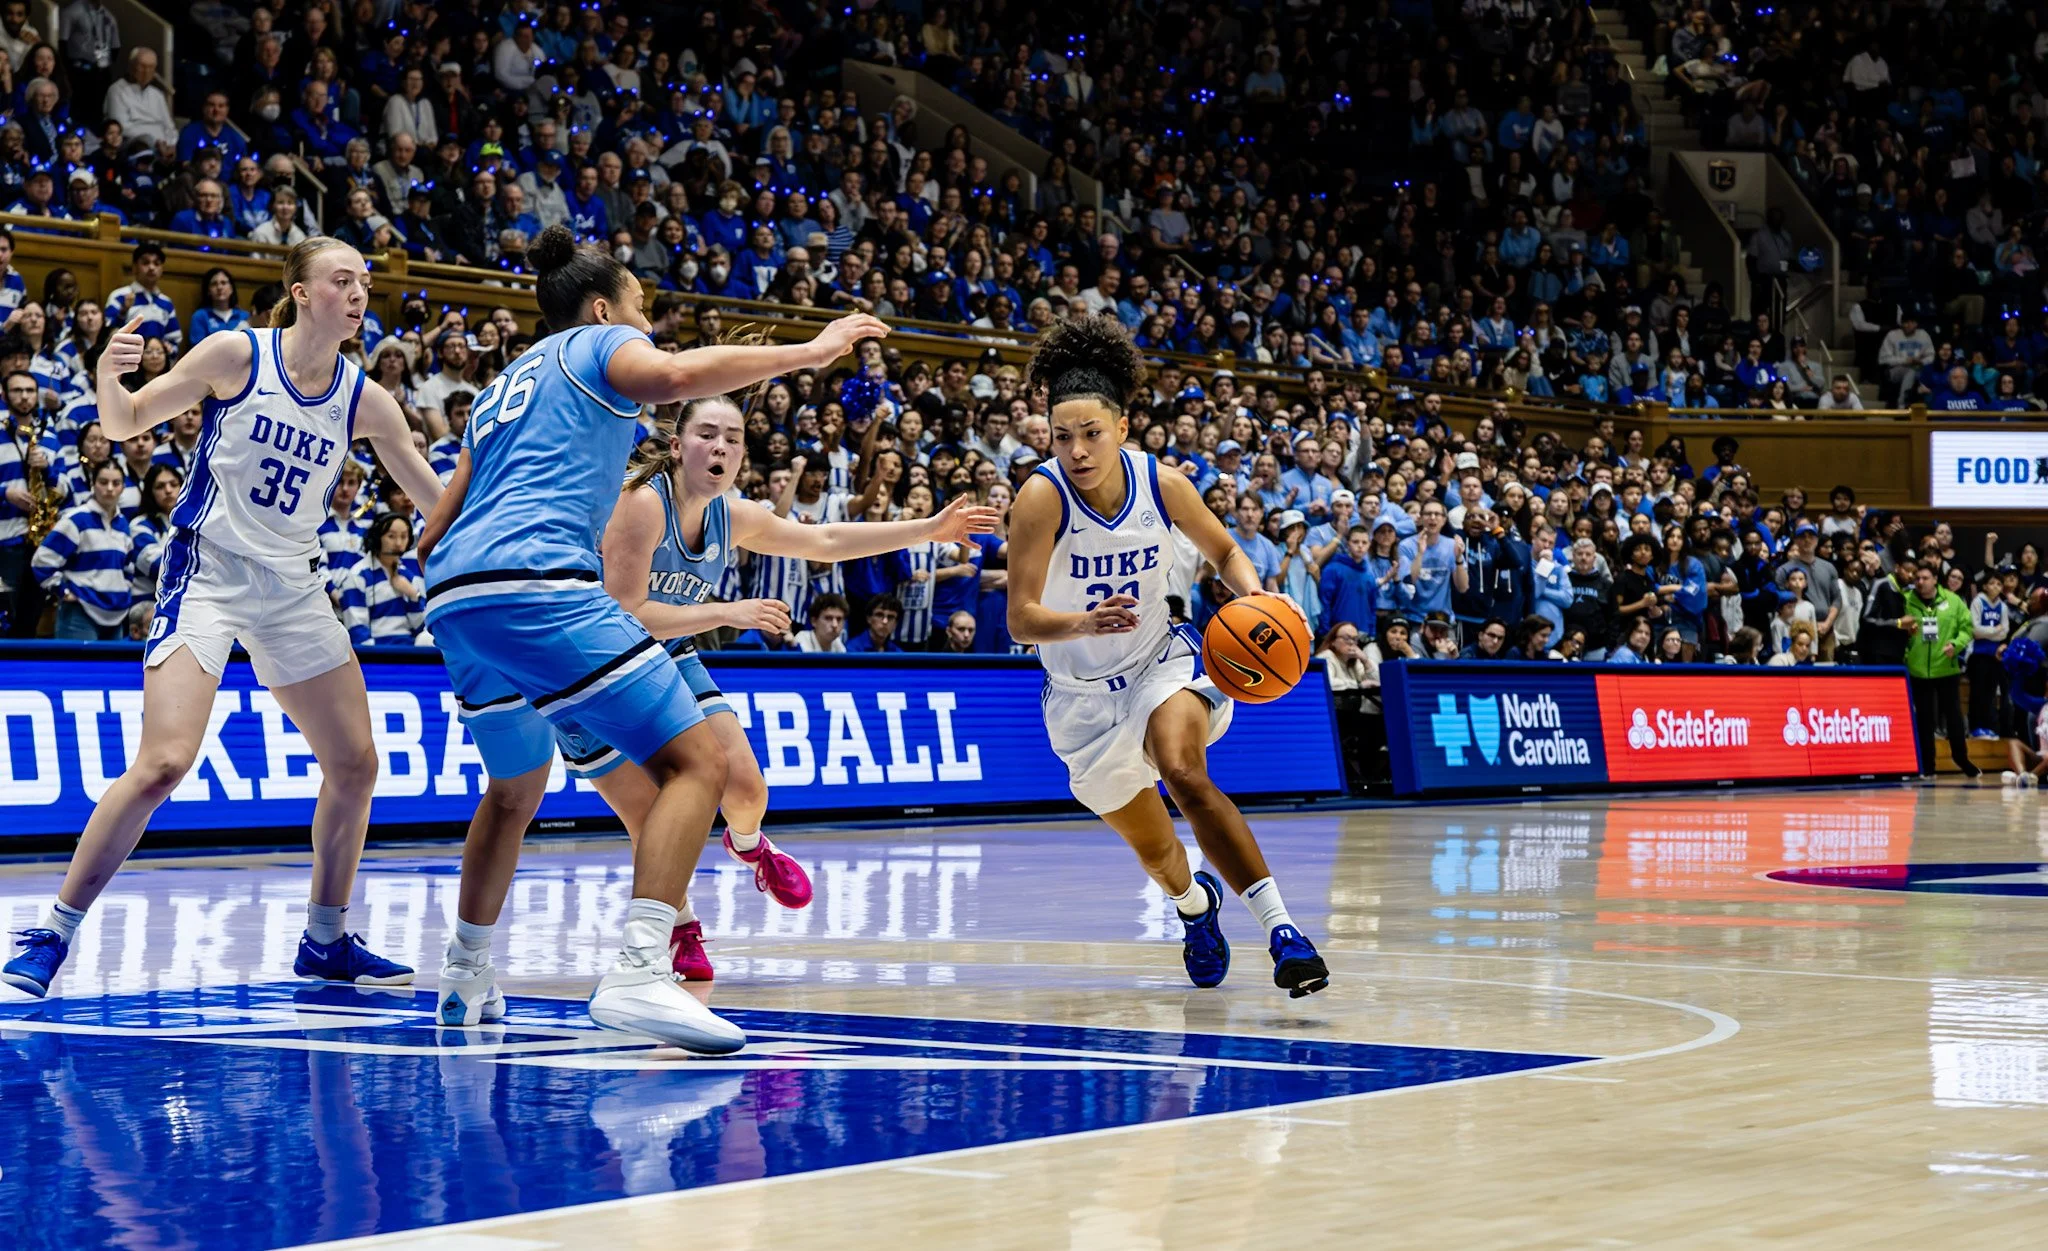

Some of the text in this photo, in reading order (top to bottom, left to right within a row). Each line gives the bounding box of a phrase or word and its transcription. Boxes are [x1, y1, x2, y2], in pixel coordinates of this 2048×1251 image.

[471, 354, 545, 451] 26
[1947, 399, 1978, 410] DUKE
[249, 414, 335, 467] DUKE
[249, 457, 311, 516] 35
[1957, 457, 2030, 484] FOOD
[1070, 545, 1159, 579] DUKE
[649, 570, 713, 603] NORTH
[1502, 693, 1561, 728] North
[1508, 729, 1591, 766] Carolina
